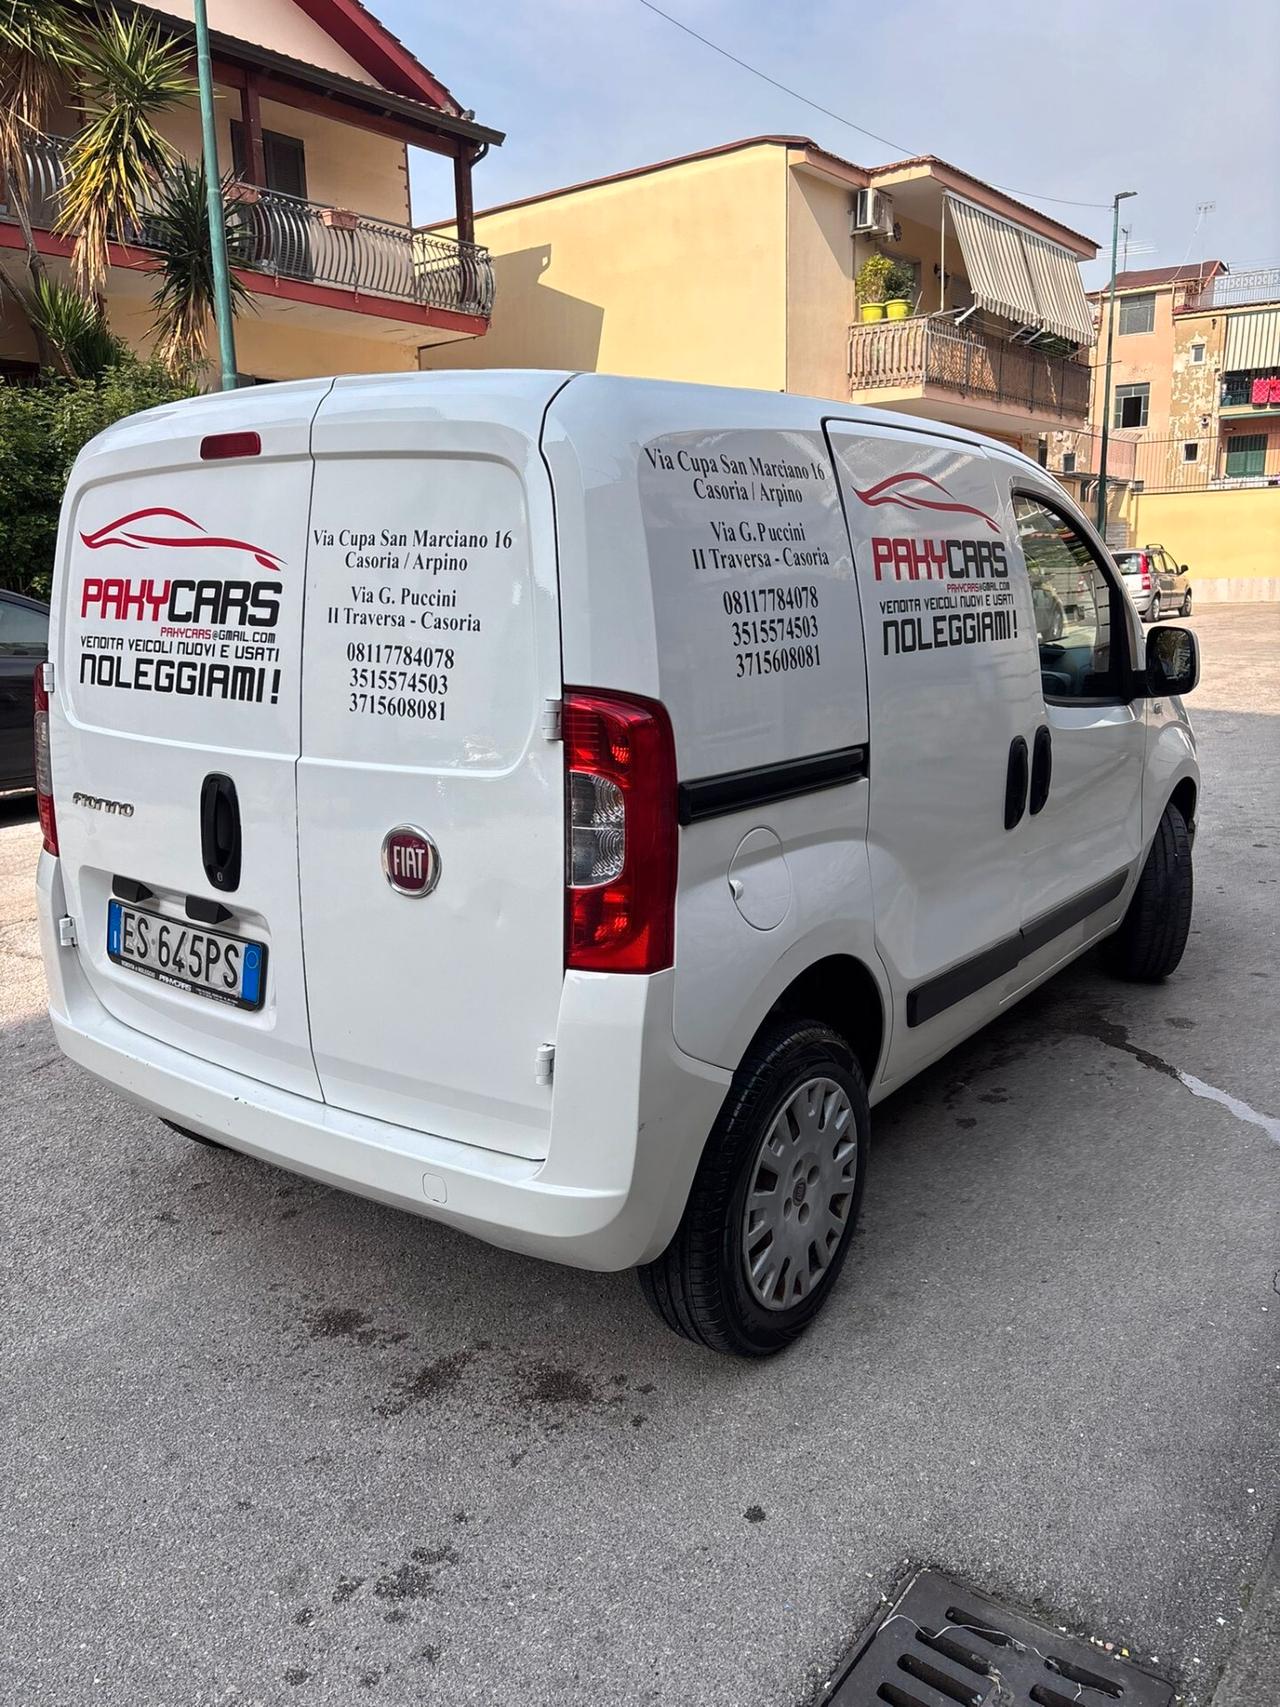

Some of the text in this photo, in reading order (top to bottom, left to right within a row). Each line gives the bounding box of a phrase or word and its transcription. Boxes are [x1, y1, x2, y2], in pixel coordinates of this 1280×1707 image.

[644, 447, 826, 481] Via Cupa San Marciano 16
[693, 477, 749, 501] Casoria
[760, 483, 803, 507] Arpino
[313, 528, 513, 551] Via Cupa San Marciano 16
[710, 521, 737, 542] Via
[345, 551, 399, 569] Casoria
[412, 553, 468, 575] Arpino
[708, 548, 772, 569] Traversa
[782, 546, 830, 567] Casoria
[871, 537, 1009, 581] PAKYCARS
[80, 577, 283, 627] PAKYCARS
[351, 586, 457, 608] Via G. Puccini
[722, 585, 819, 616] 08117784078
[879, 593, 1014, 614] VENDITA VEICOLI NUOVI E USATI
[343, 607, 406, 628] Traversa
[421, 611, 481, 632] Casoria
[731, 615, 819, 647] 3515574503
[80, 635, 280, 662] VENDITA VEICOLI NUOVI E USATI
[346, 641, 455, 670] 08117784078
[736, 644, 821, 678] 3715608081
[349, 667, 449, 695] 3515574503
[349, 692, 446, 721] 3715608081
[393, 845, 426, 880] FIAT
[122, 911, 149, 959] ES
